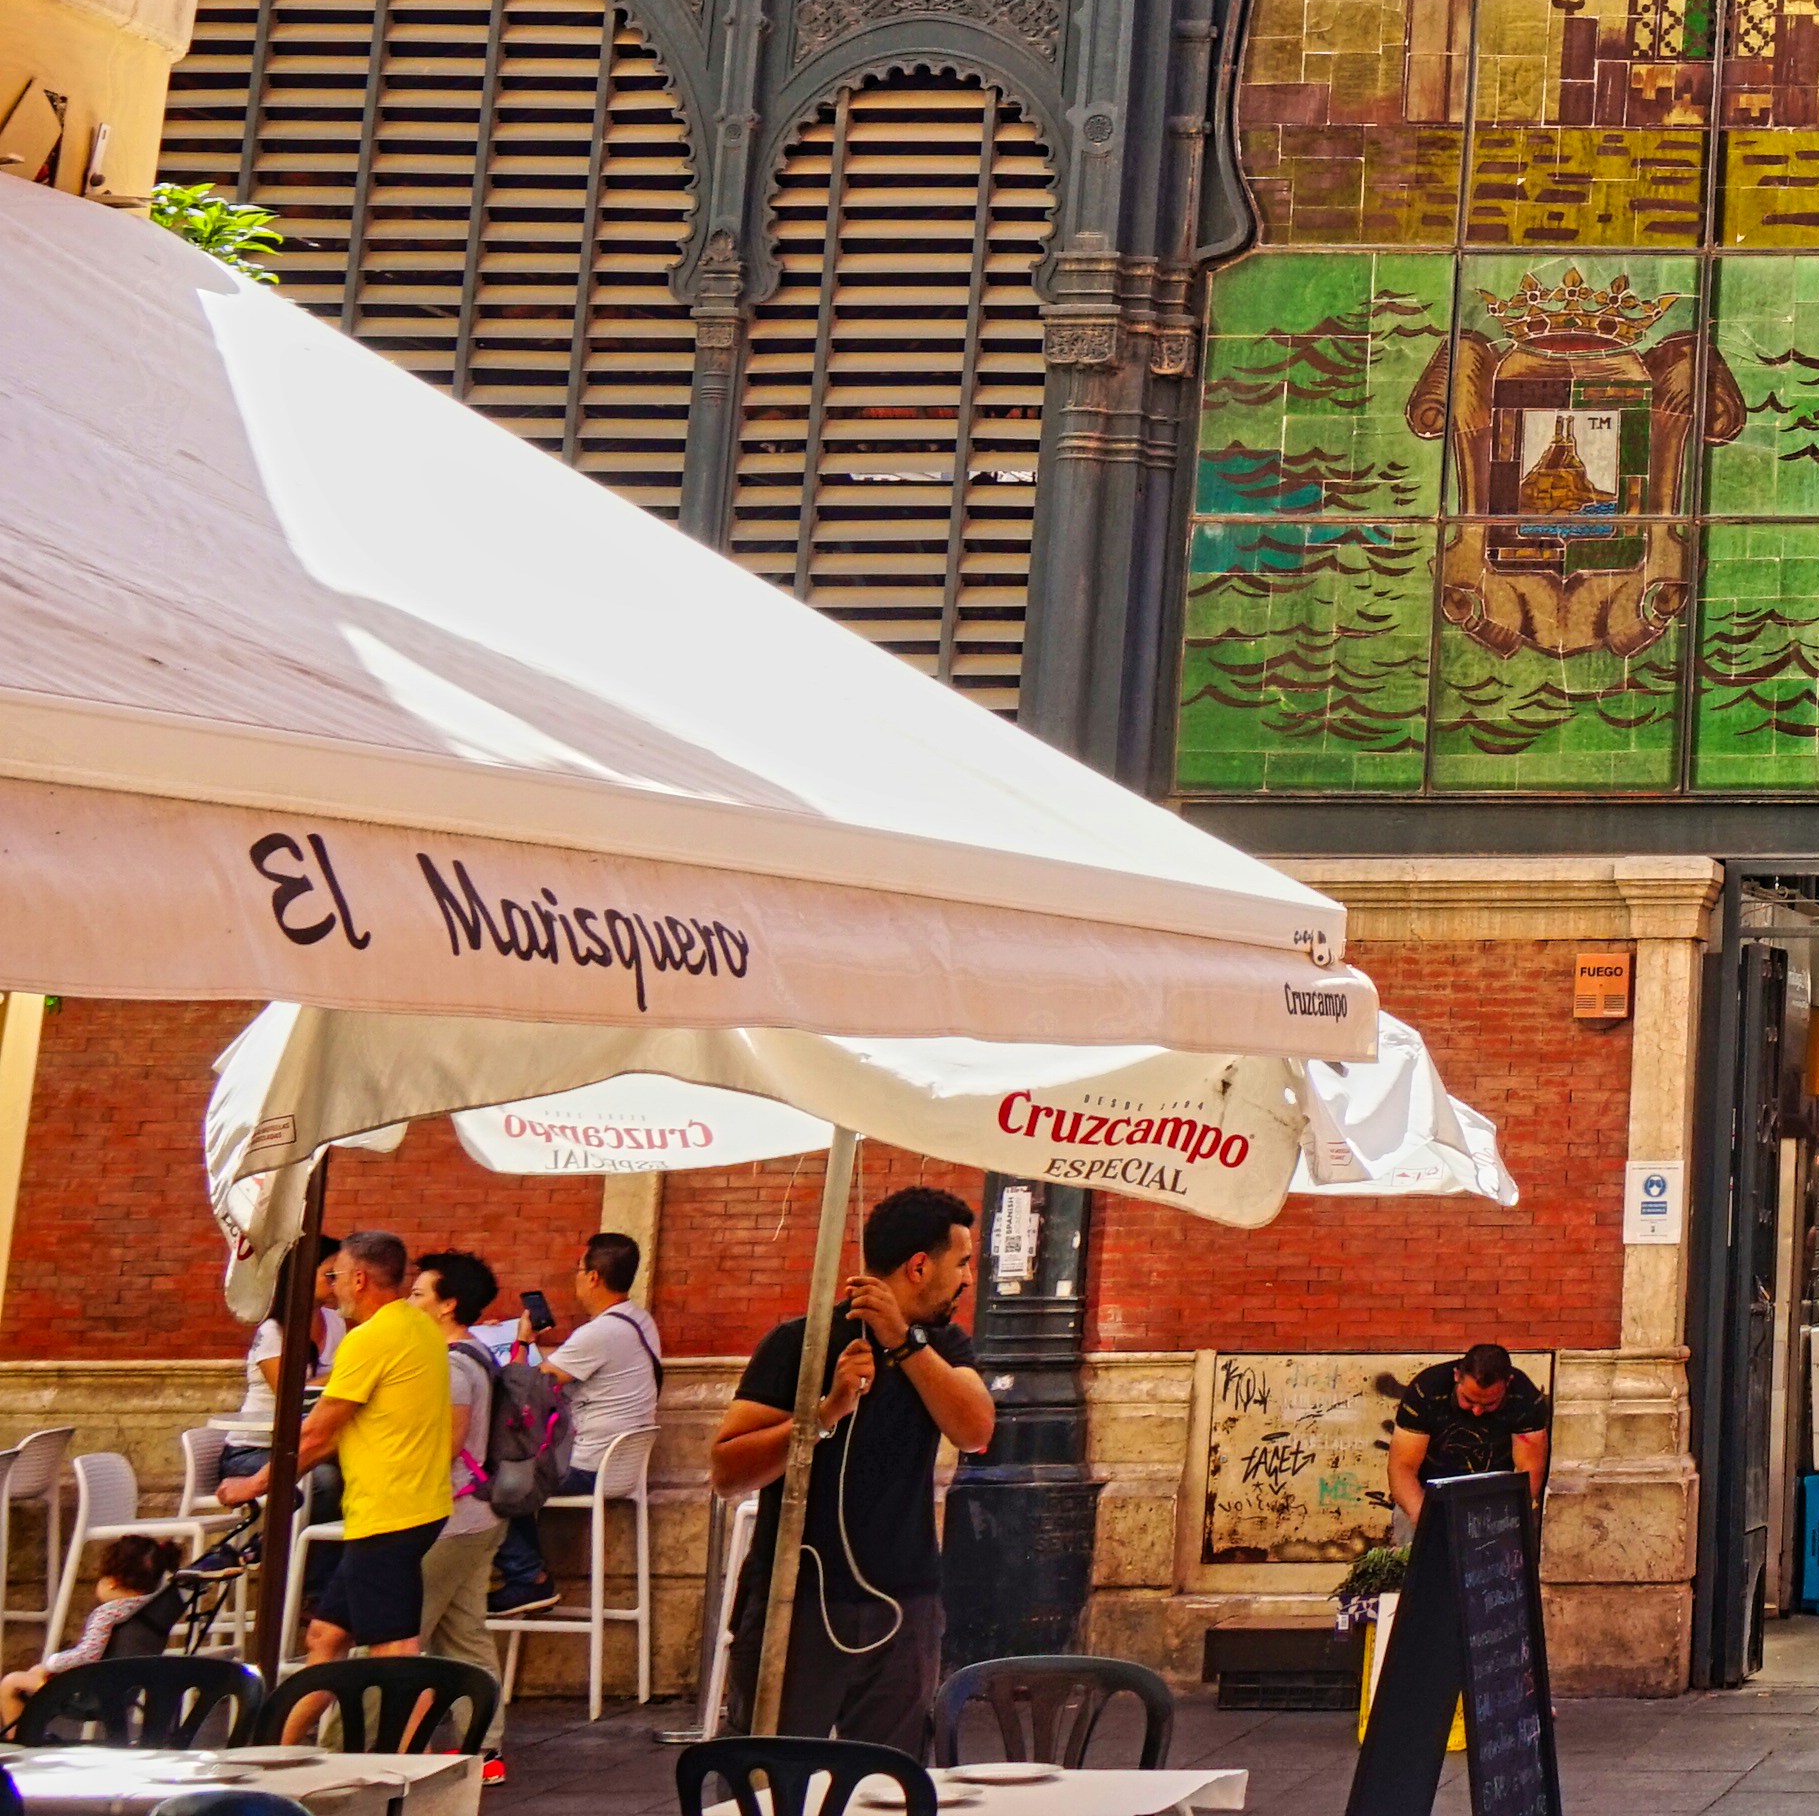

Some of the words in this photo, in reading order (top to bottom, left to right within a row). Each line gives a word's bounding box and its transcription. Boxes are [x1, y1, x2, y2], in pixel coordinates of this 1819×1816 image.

[249, 832, 370, 950] El
[416, 852, 750, 1012] Marisquero
[1580, 966, 1624, 977] FUEGO
[1284, 982, 1348, 1023] Cruzcampo
[998, 1089, 1250, 1168] Cruzcampo
[1043, 1157, 1188, 1195] ESPECIAL
